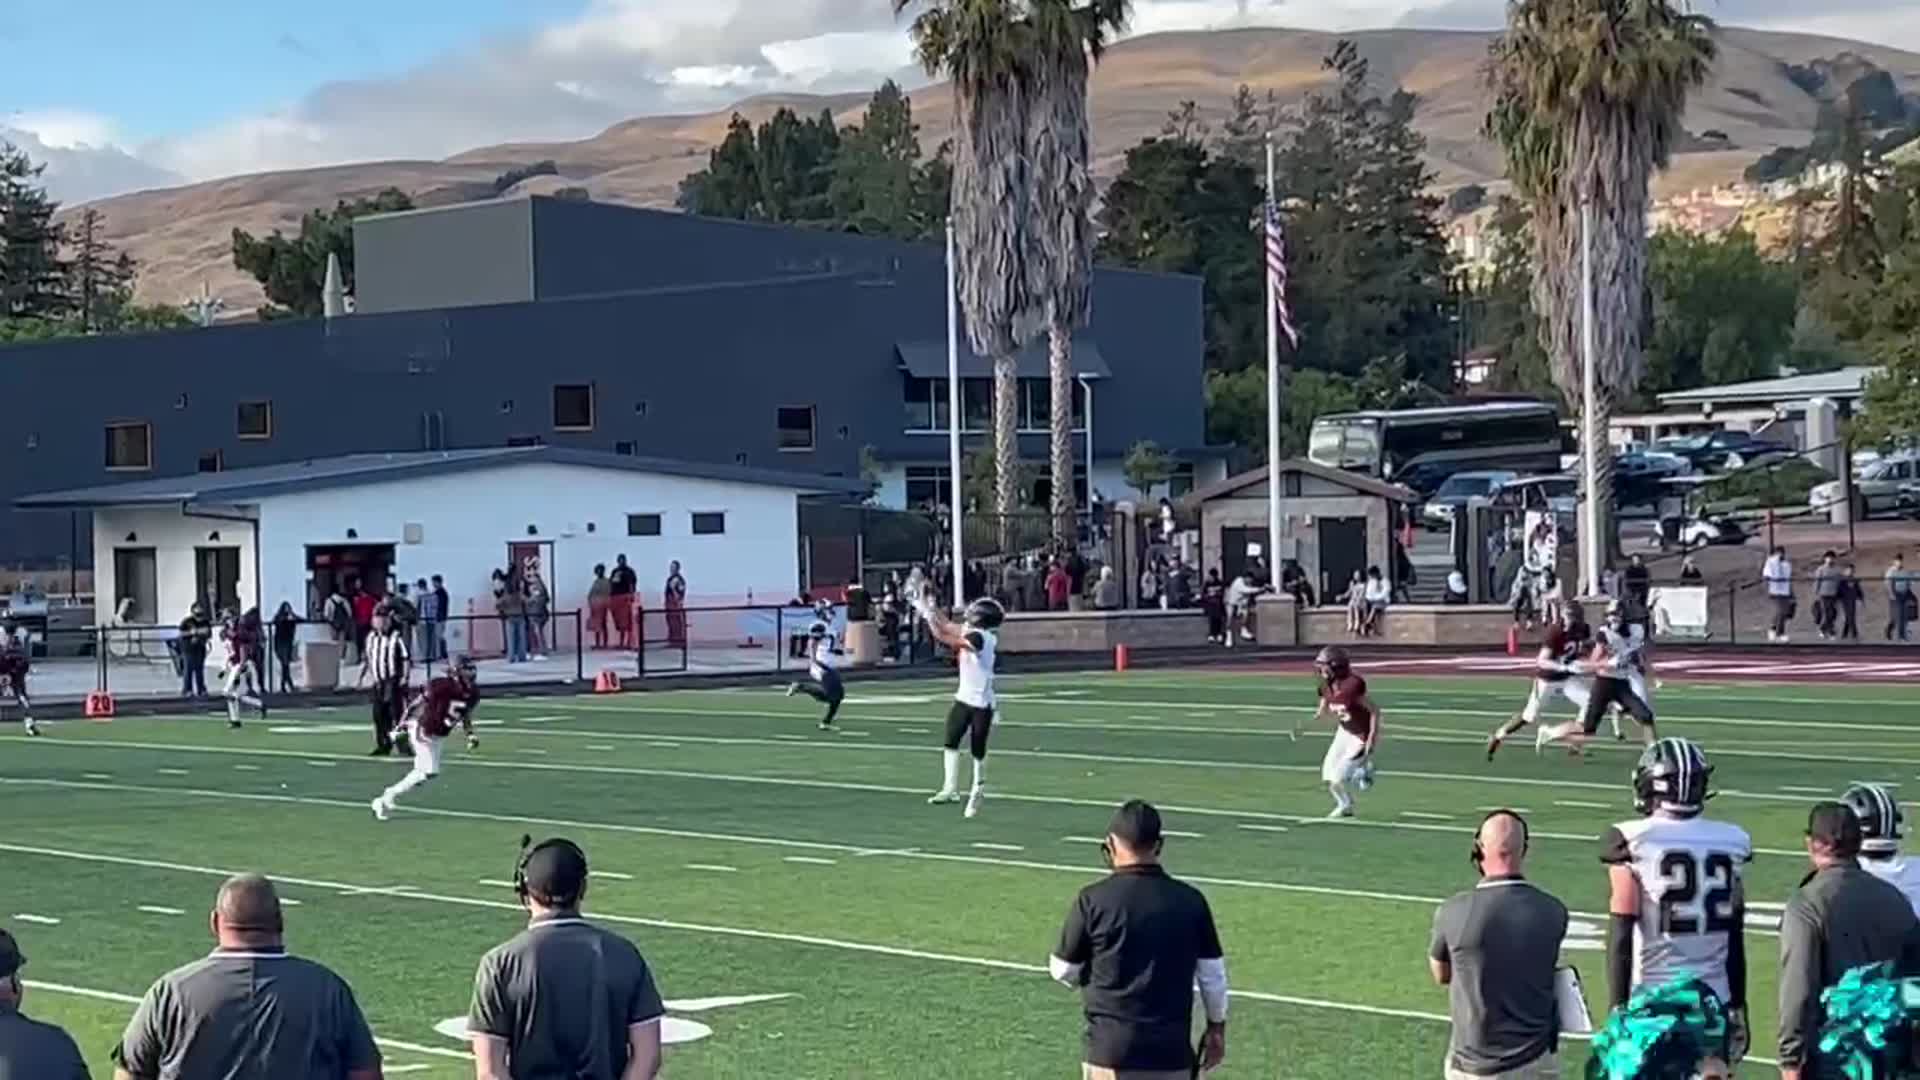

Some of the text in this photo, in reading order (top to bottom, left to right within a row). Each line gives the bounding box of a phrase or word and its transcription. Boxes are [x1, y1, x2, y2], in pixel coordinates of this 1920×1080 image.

[90, 695, 111, 712] 20
[444, 700, 467, 727] 5
[1659, 850, 1735, 933] 22
